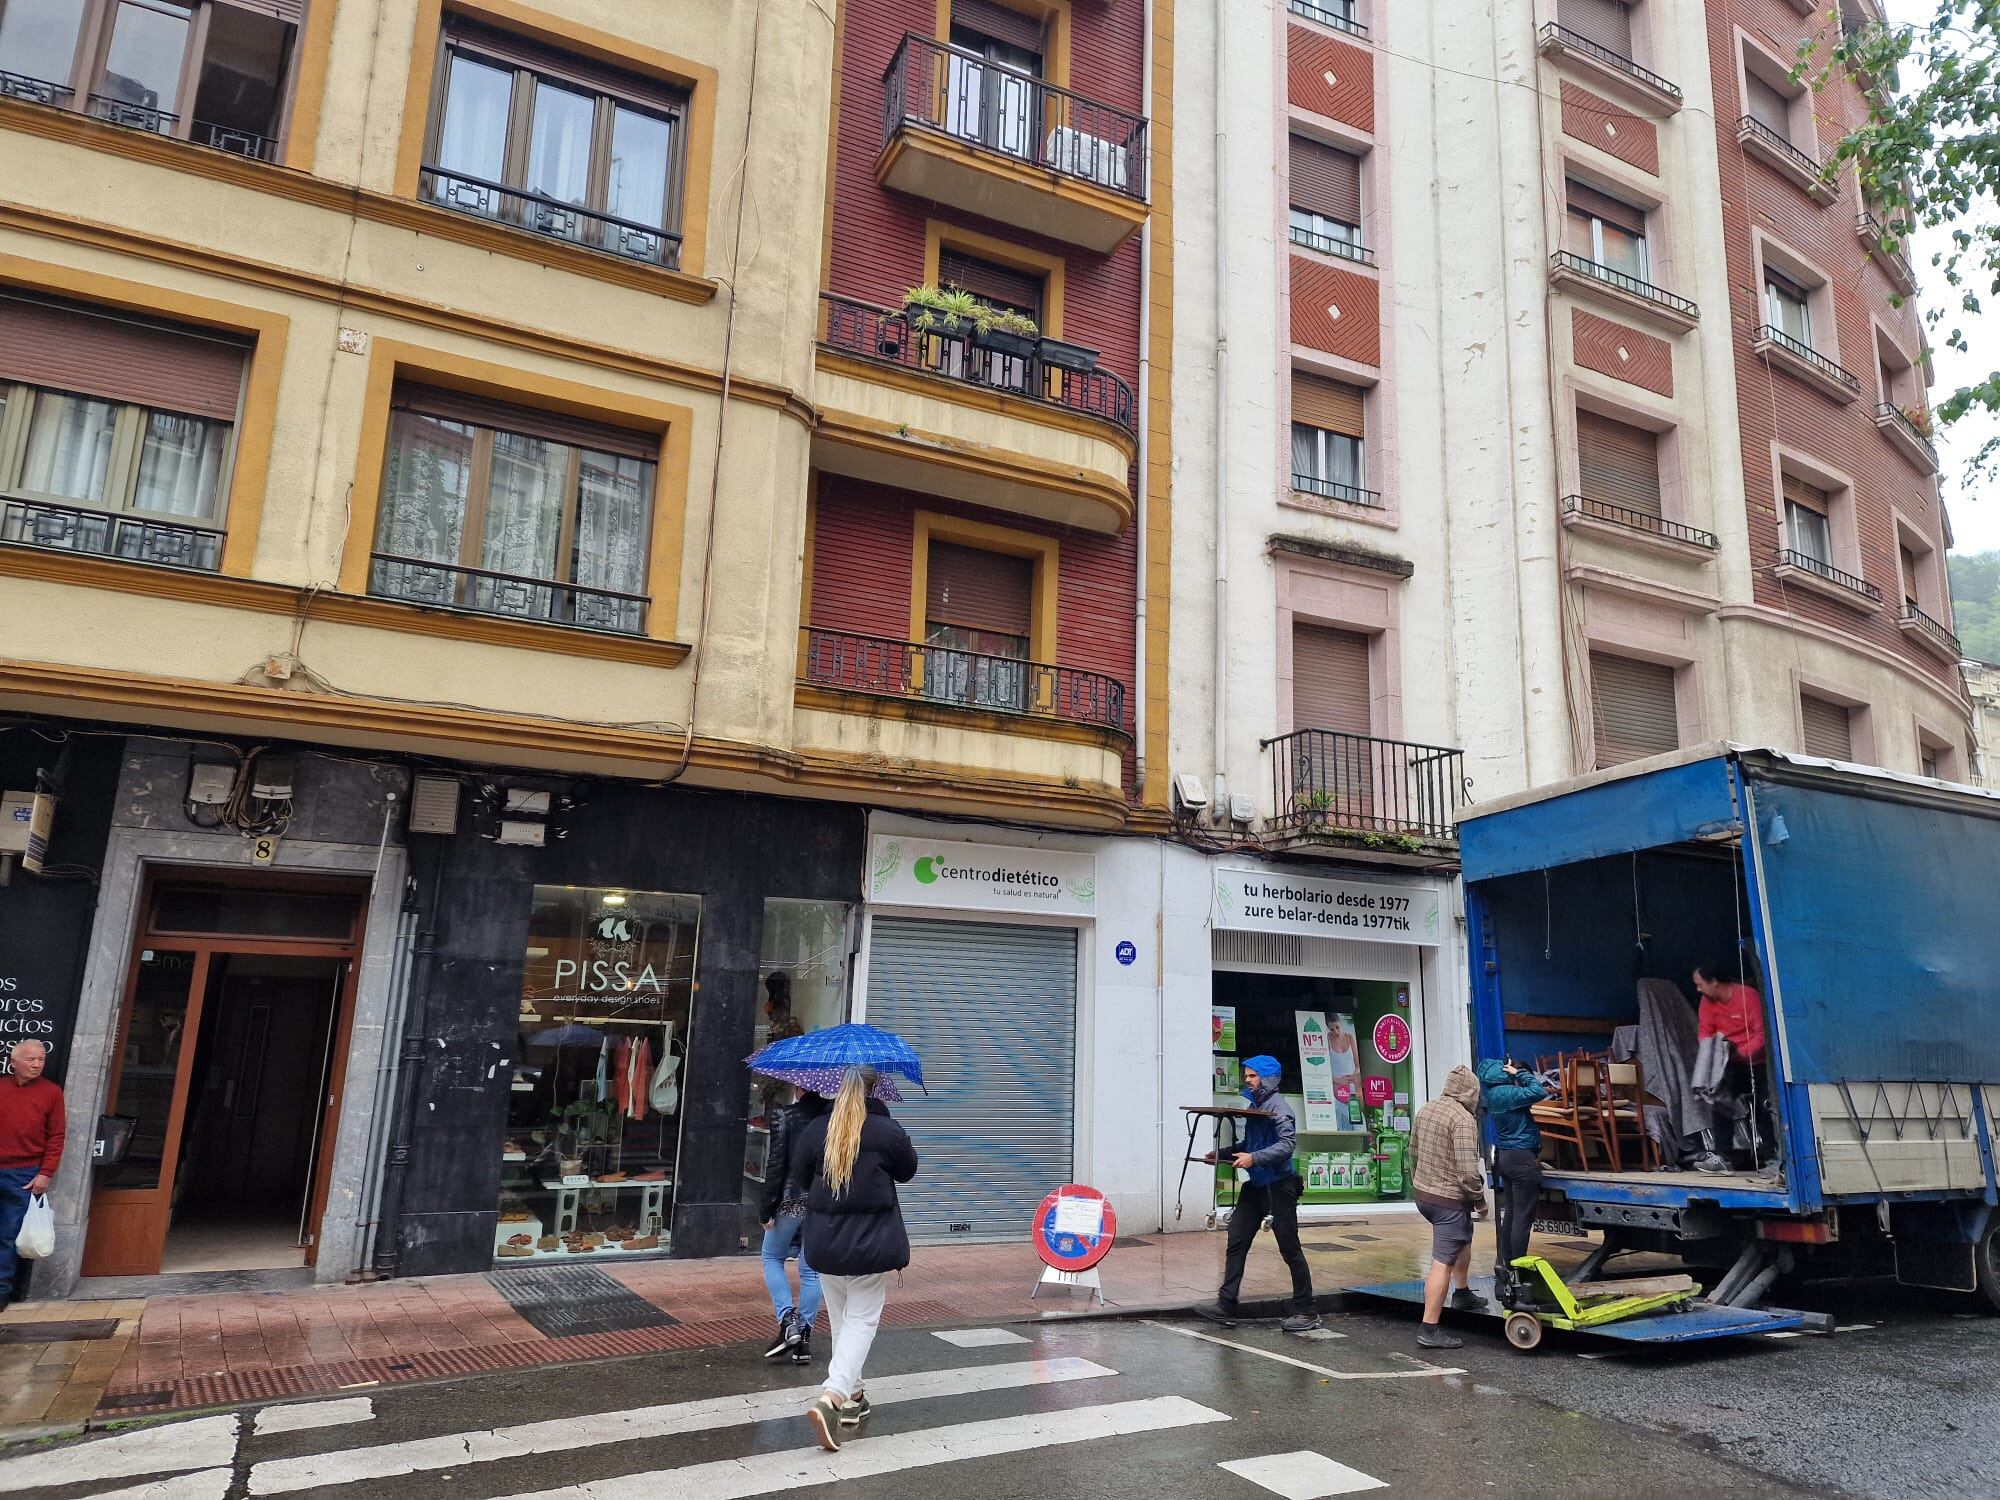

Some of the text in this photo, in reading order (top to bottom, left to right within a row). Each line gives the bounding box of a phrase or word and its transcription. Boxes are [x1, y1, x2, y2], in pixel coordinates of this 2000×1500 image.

[256, 840, 271, 858] 8
[941, 865, 1059, 887] centrodietético
[993, 887, 1001, 896] tu
[1003, 888, 1022, 897] salud
[1243, 883, 1410, 912] tu herbolario desde 1977
[1244, 905, 1411, 931] zure belar-denda 1977tik
[1119, 947, 1133, 957] ADT
[554, 959, 661, 992] PISSA
[553, 994, 661, 1004] everyday design shoes
